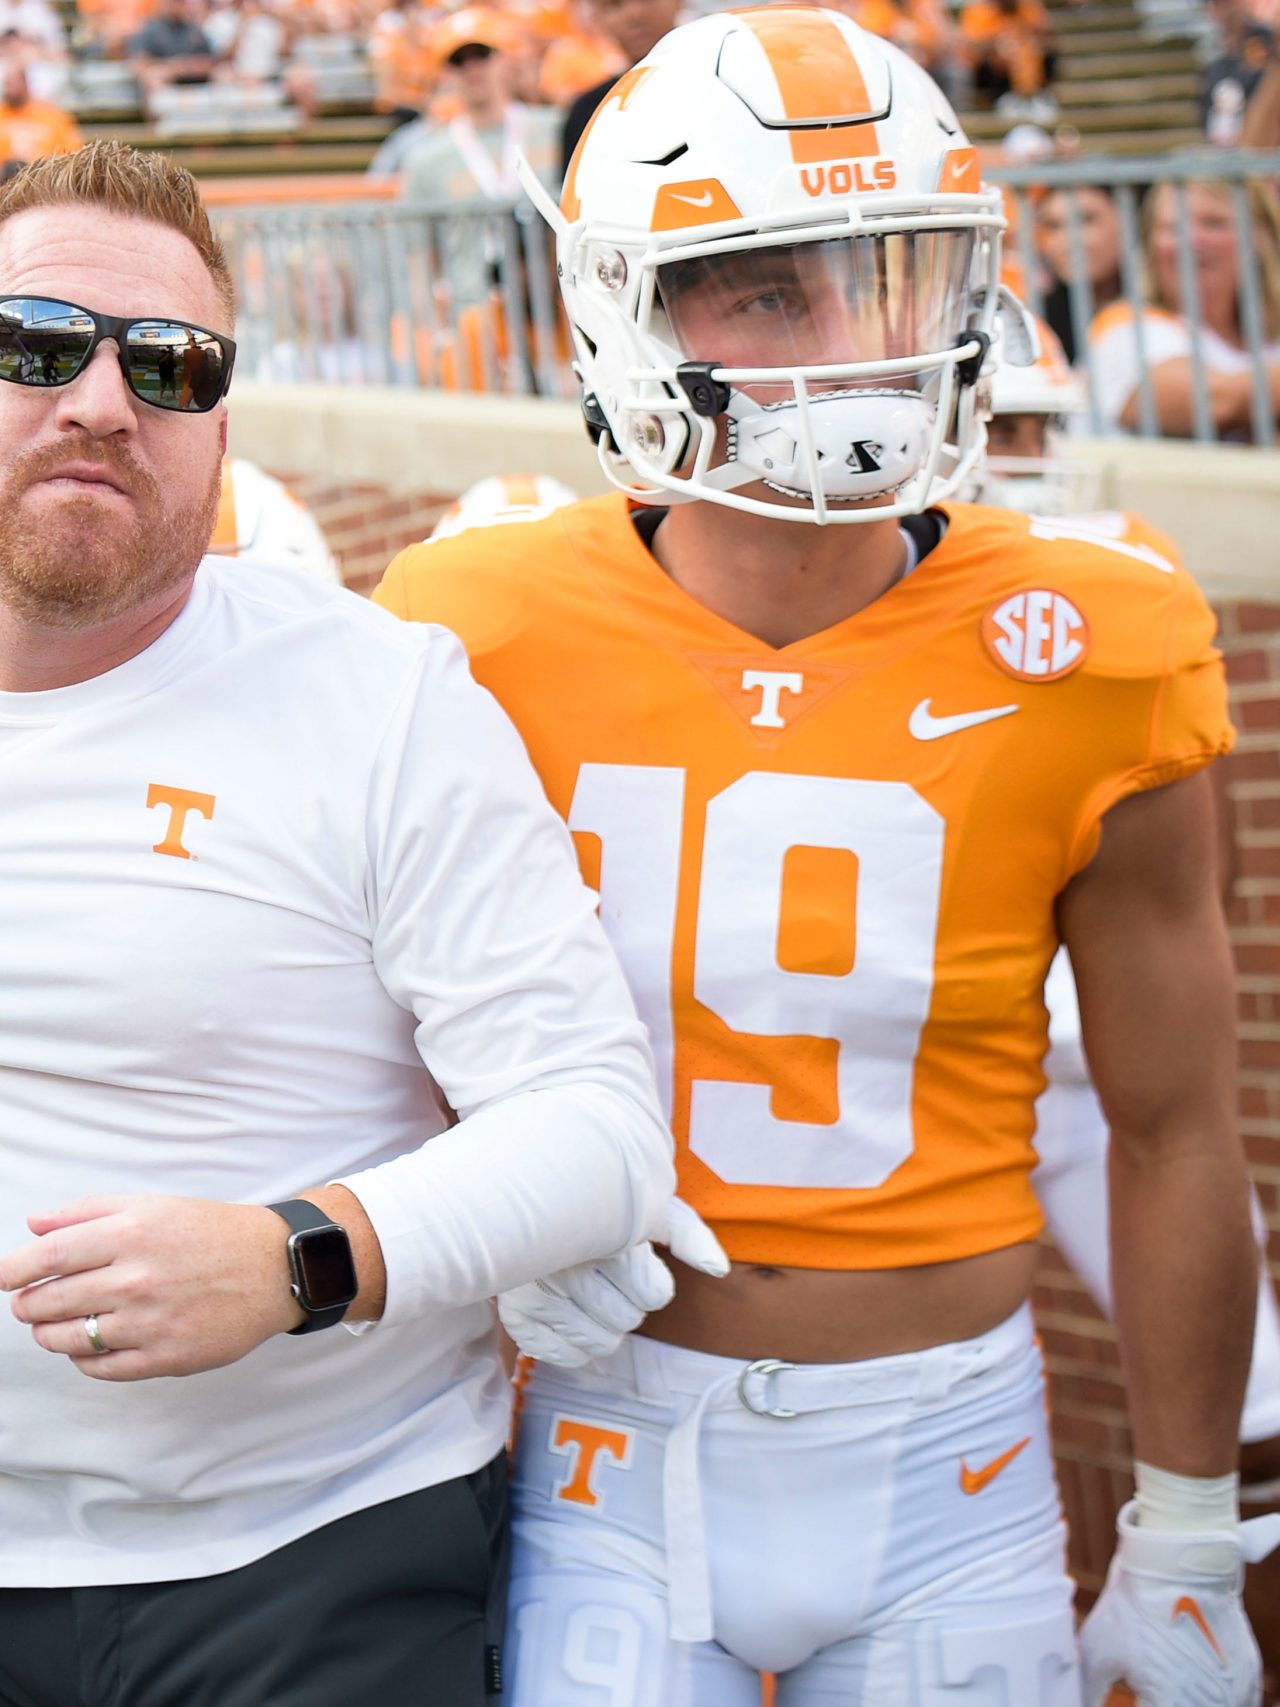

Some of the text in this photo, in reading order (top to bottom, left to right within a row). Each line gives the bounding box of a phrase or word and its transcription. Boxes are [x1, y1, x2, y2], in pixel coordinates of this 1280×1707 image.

[800, 160, 897, 197] VOLS
[992, 590, 1081, 674] SEC
[741, 670, 803, 728] T
[145, 783, 217, 860] T
[567, 762, 946, 1190] 19
[549, 1411, 638, 1508] T
